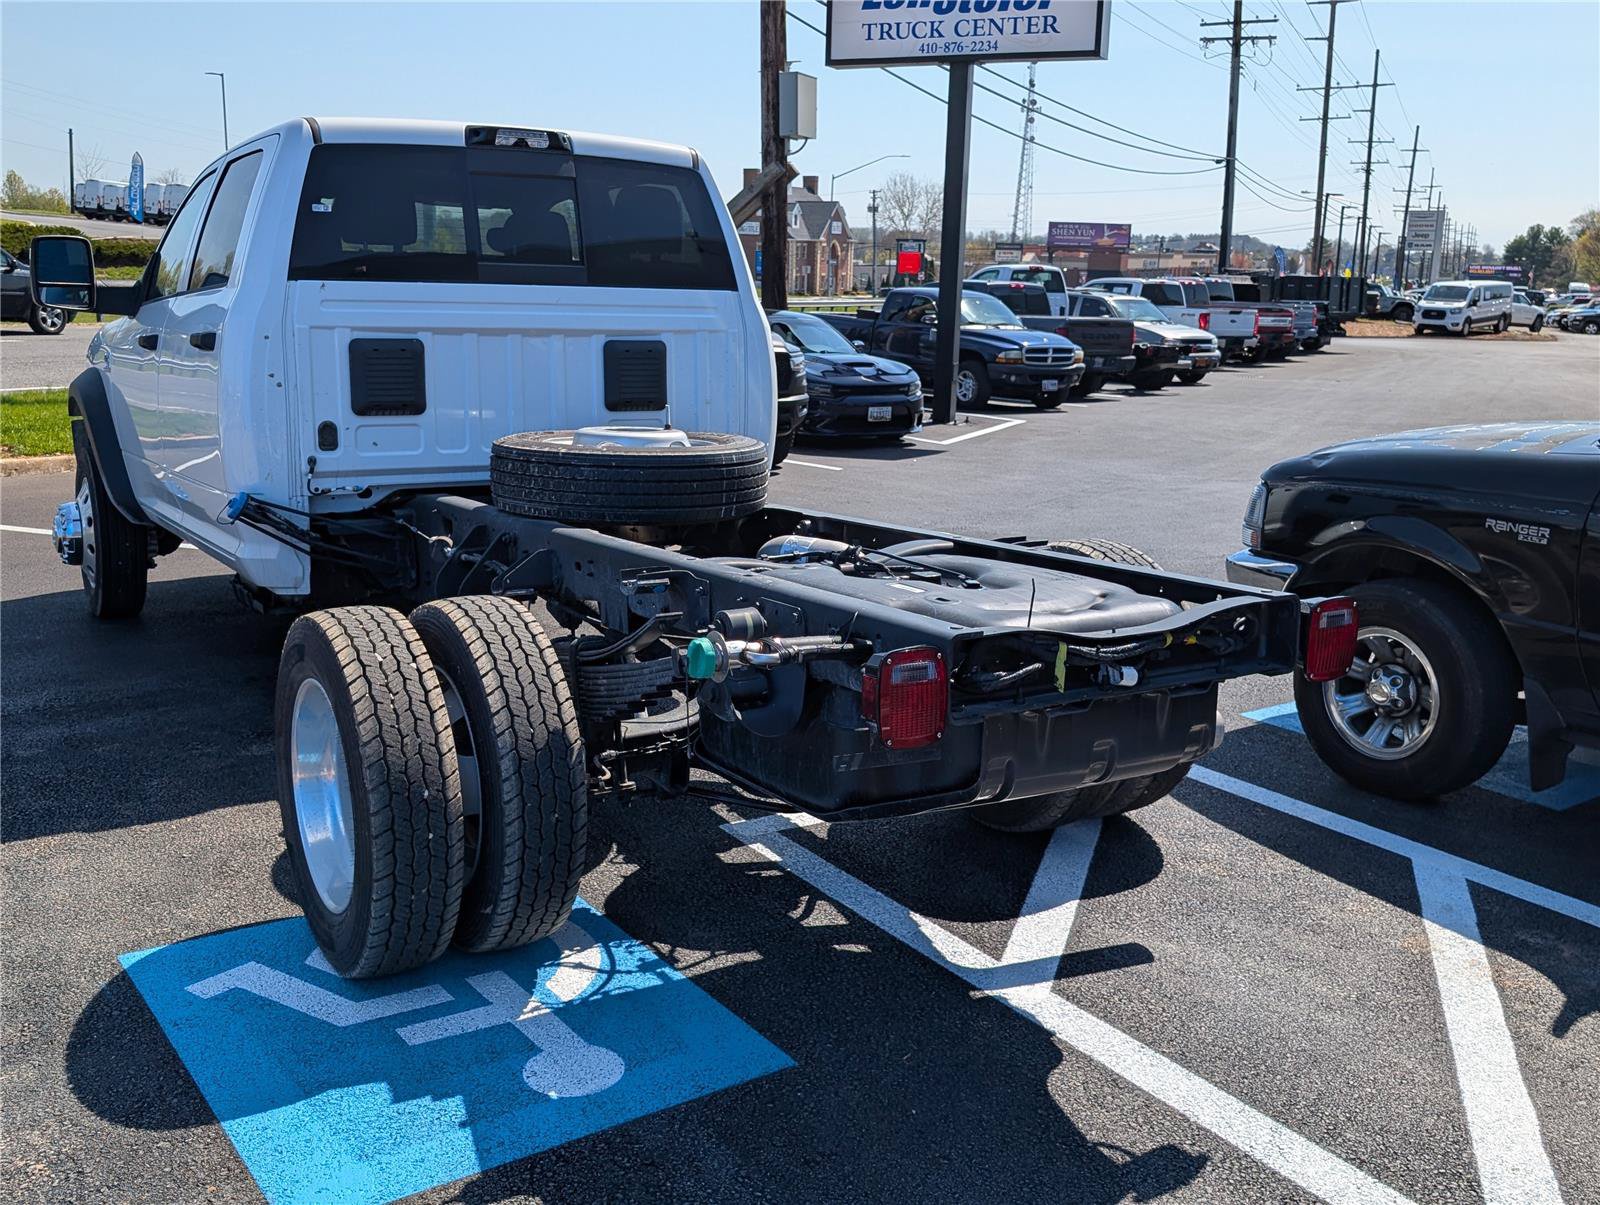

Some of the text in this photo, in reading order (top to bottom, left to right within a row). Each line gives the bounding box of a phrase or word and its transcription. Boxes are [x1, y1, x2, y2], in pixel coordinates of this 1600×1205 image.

[862, 14, 1060, 41] TRUCK CENTER
[918, 40, 998, 54] 410-876-2234
[1051, 228, 1096, 237] SHEN YUN
